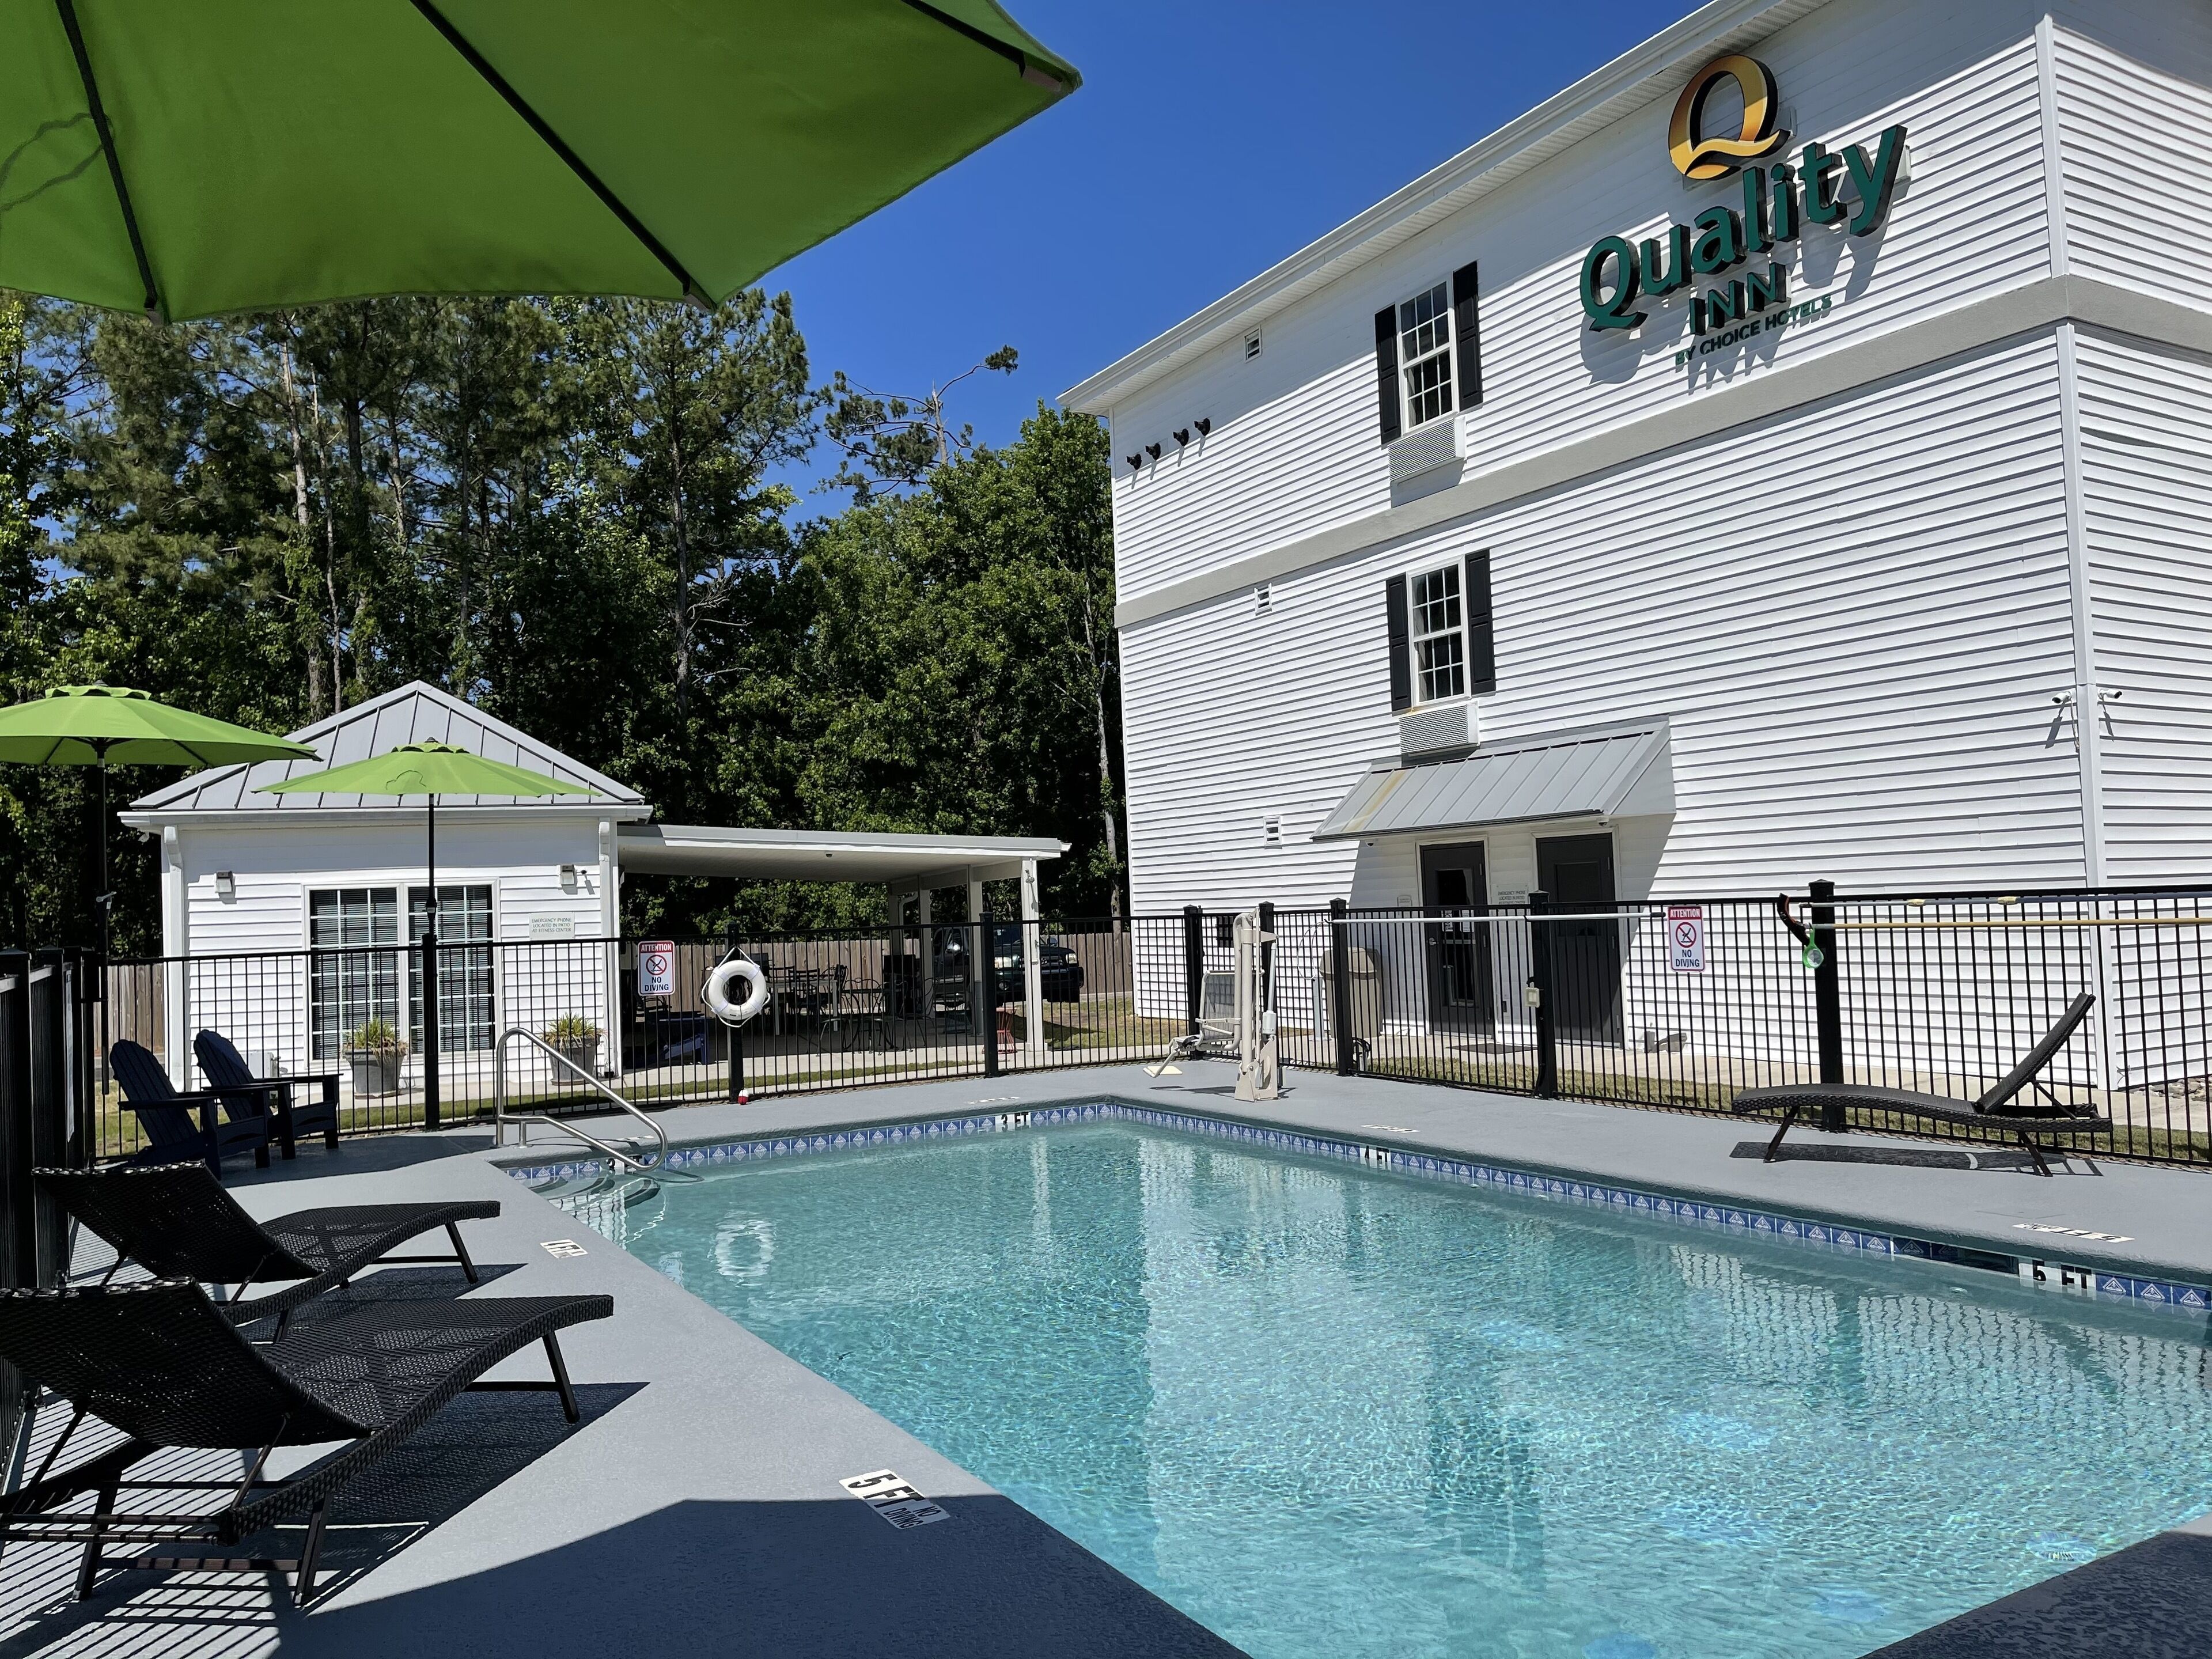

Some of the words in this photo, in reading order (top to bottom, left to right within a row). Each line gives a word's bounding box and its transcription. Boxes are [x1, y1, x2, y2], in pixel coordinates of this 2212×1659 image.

[1669, 54, 1791, 181] Q
[1580, 124, 1908, 332] Quality
[1689, 262, 1787, 336] INN
[1675, 346, 1696, 365] BY
[1699, 320, 1761, 355] CHOICE
[1765, 295, 1832, 331] HOTELS
[1671, 908, 1700, 918] ATTENTION
[641, 943, 672, 952] ATTENTION
[1682, 949, 1692, 957] NO
[1675, 959, 1700, 967] DIVING
[2032, 1259, 2047, 1282] 5
[2061, 1264, 2092, 1289] FT
[848, 1474, 898, 1488] 5
[863, 1486, 926, 1508] FT
[883, 1507, 924, 1529] DIVING
[912, 1506, 942, 1517] NO
